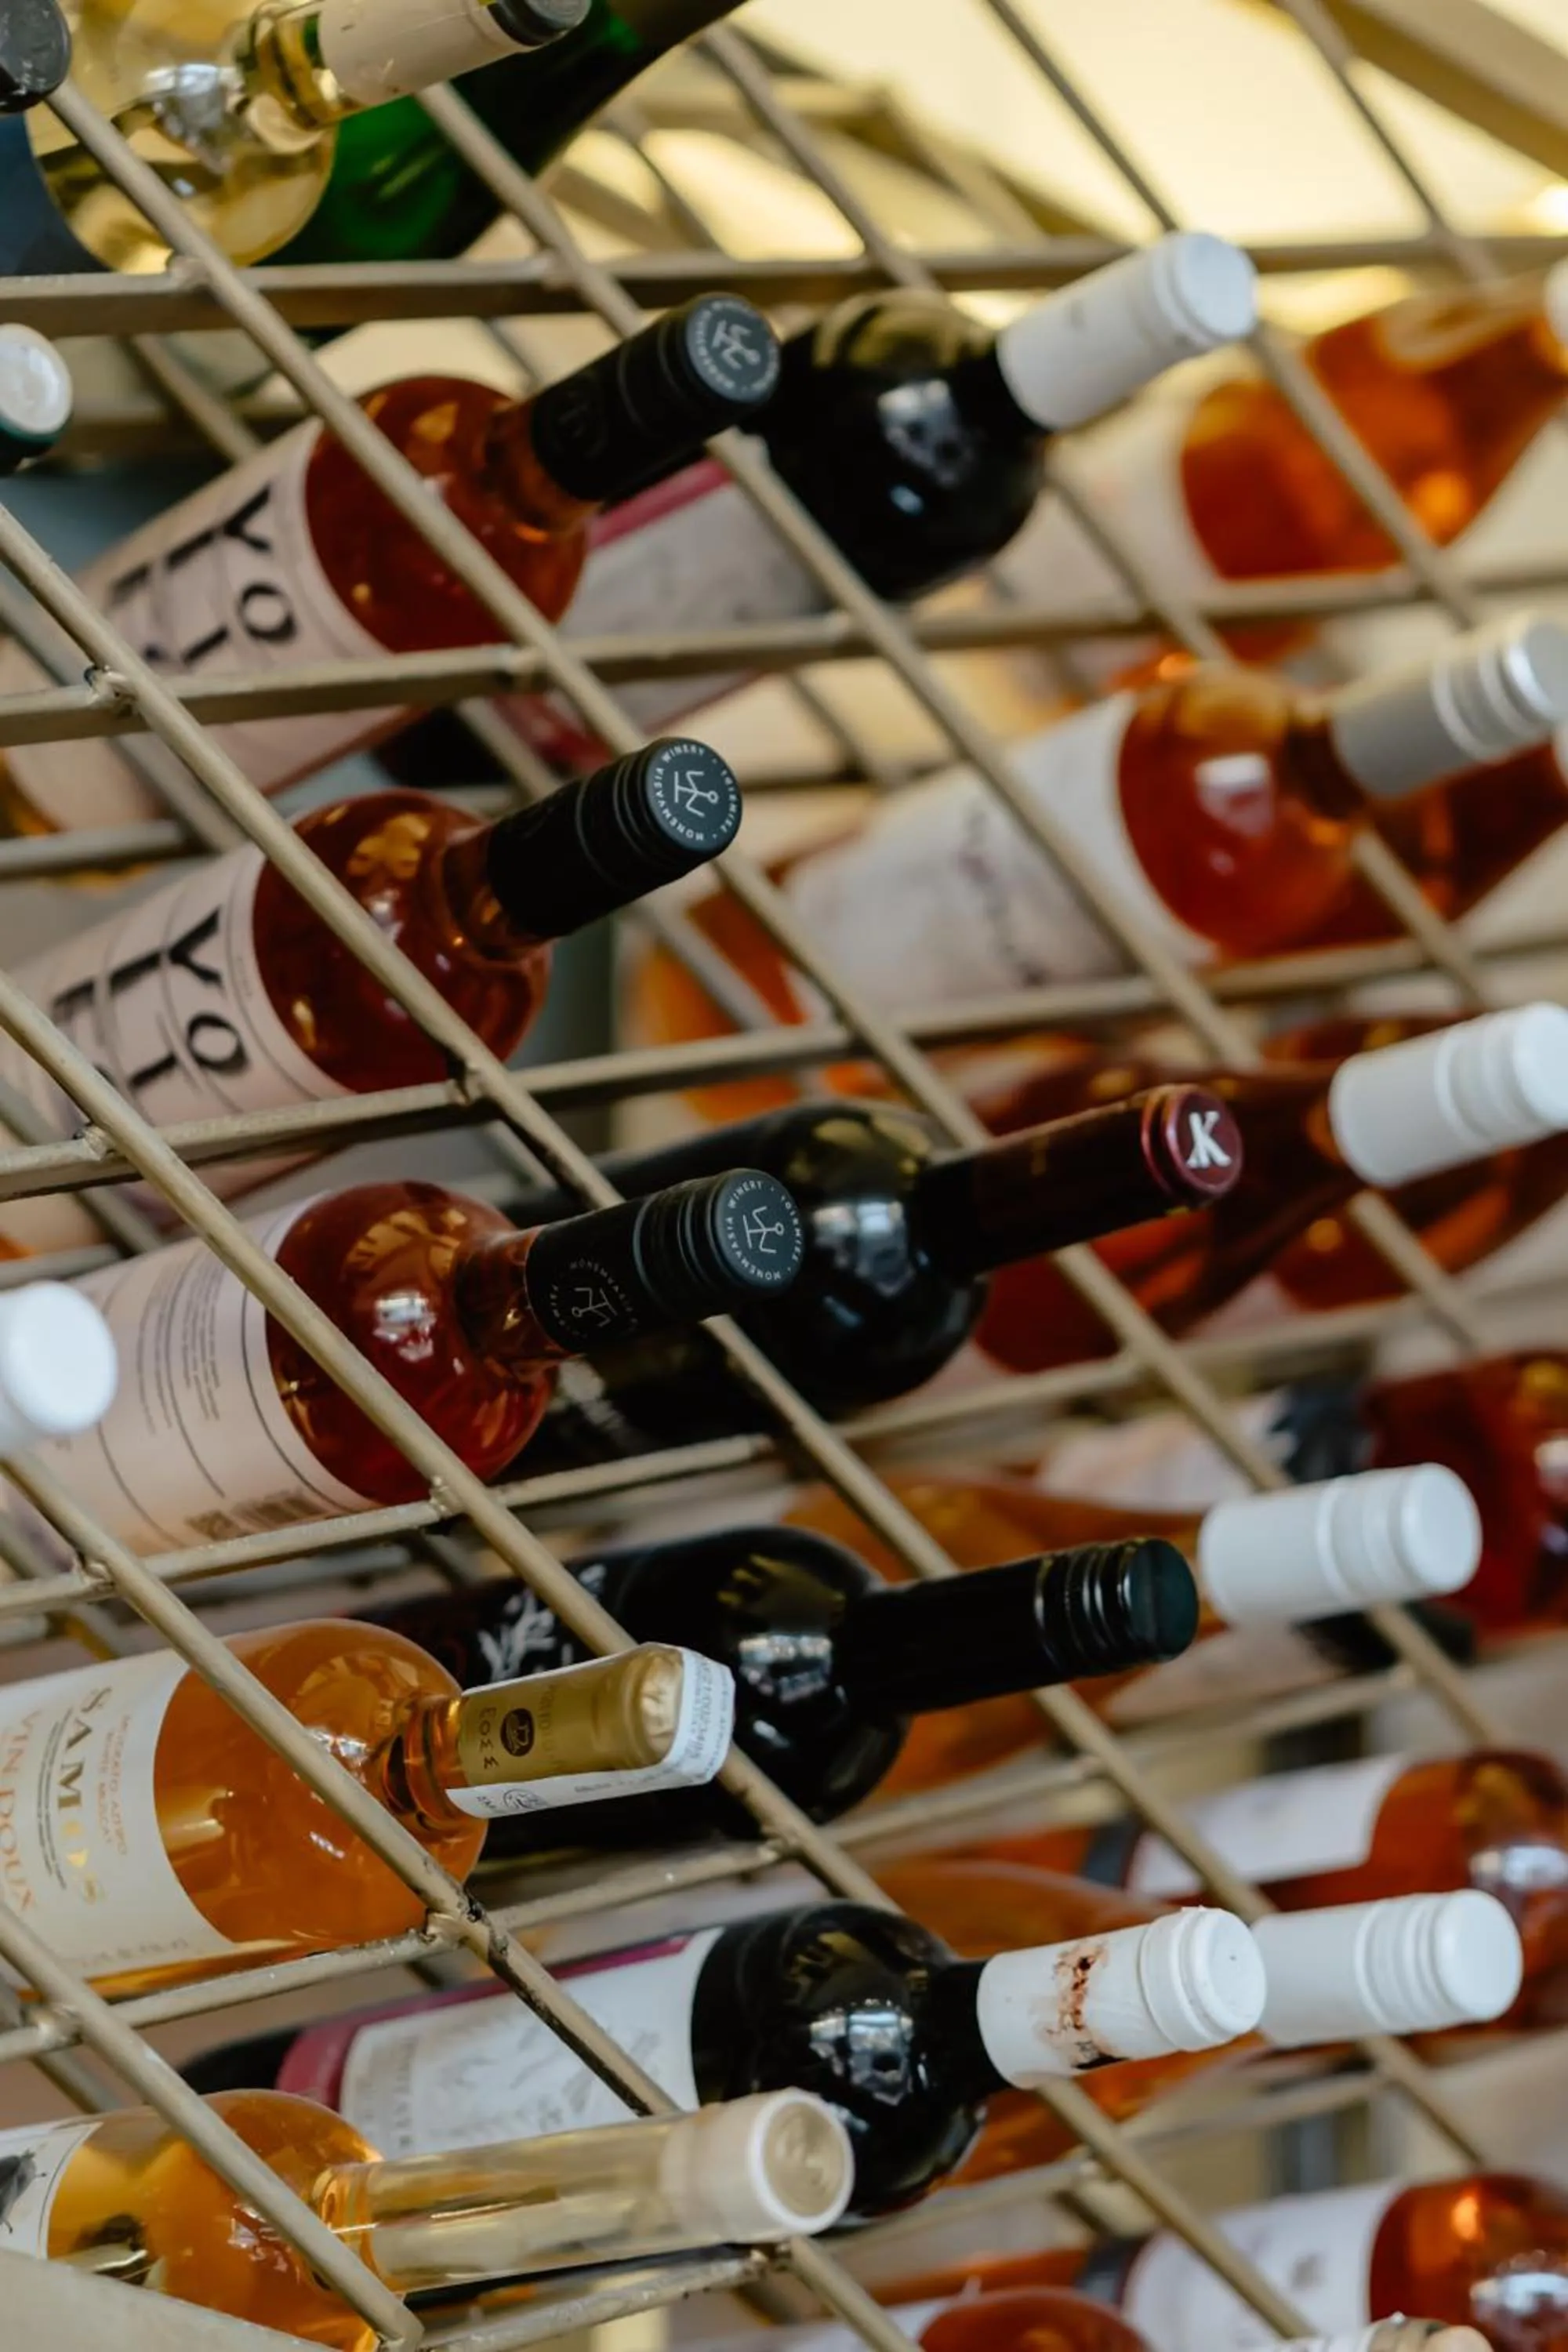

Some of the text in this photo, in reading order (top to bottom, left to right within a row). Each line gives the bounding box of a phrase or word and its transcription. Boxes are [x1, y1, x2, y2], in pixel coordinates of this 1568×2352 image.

[653, 743, 706, 840] MONEMVASIA WINERY
[1187, 1111, 1232, 1168] K
[726, 1180, 782, 1282] MONEMVASIA WINERY
[2, 1710, 43, 1774] VIN
